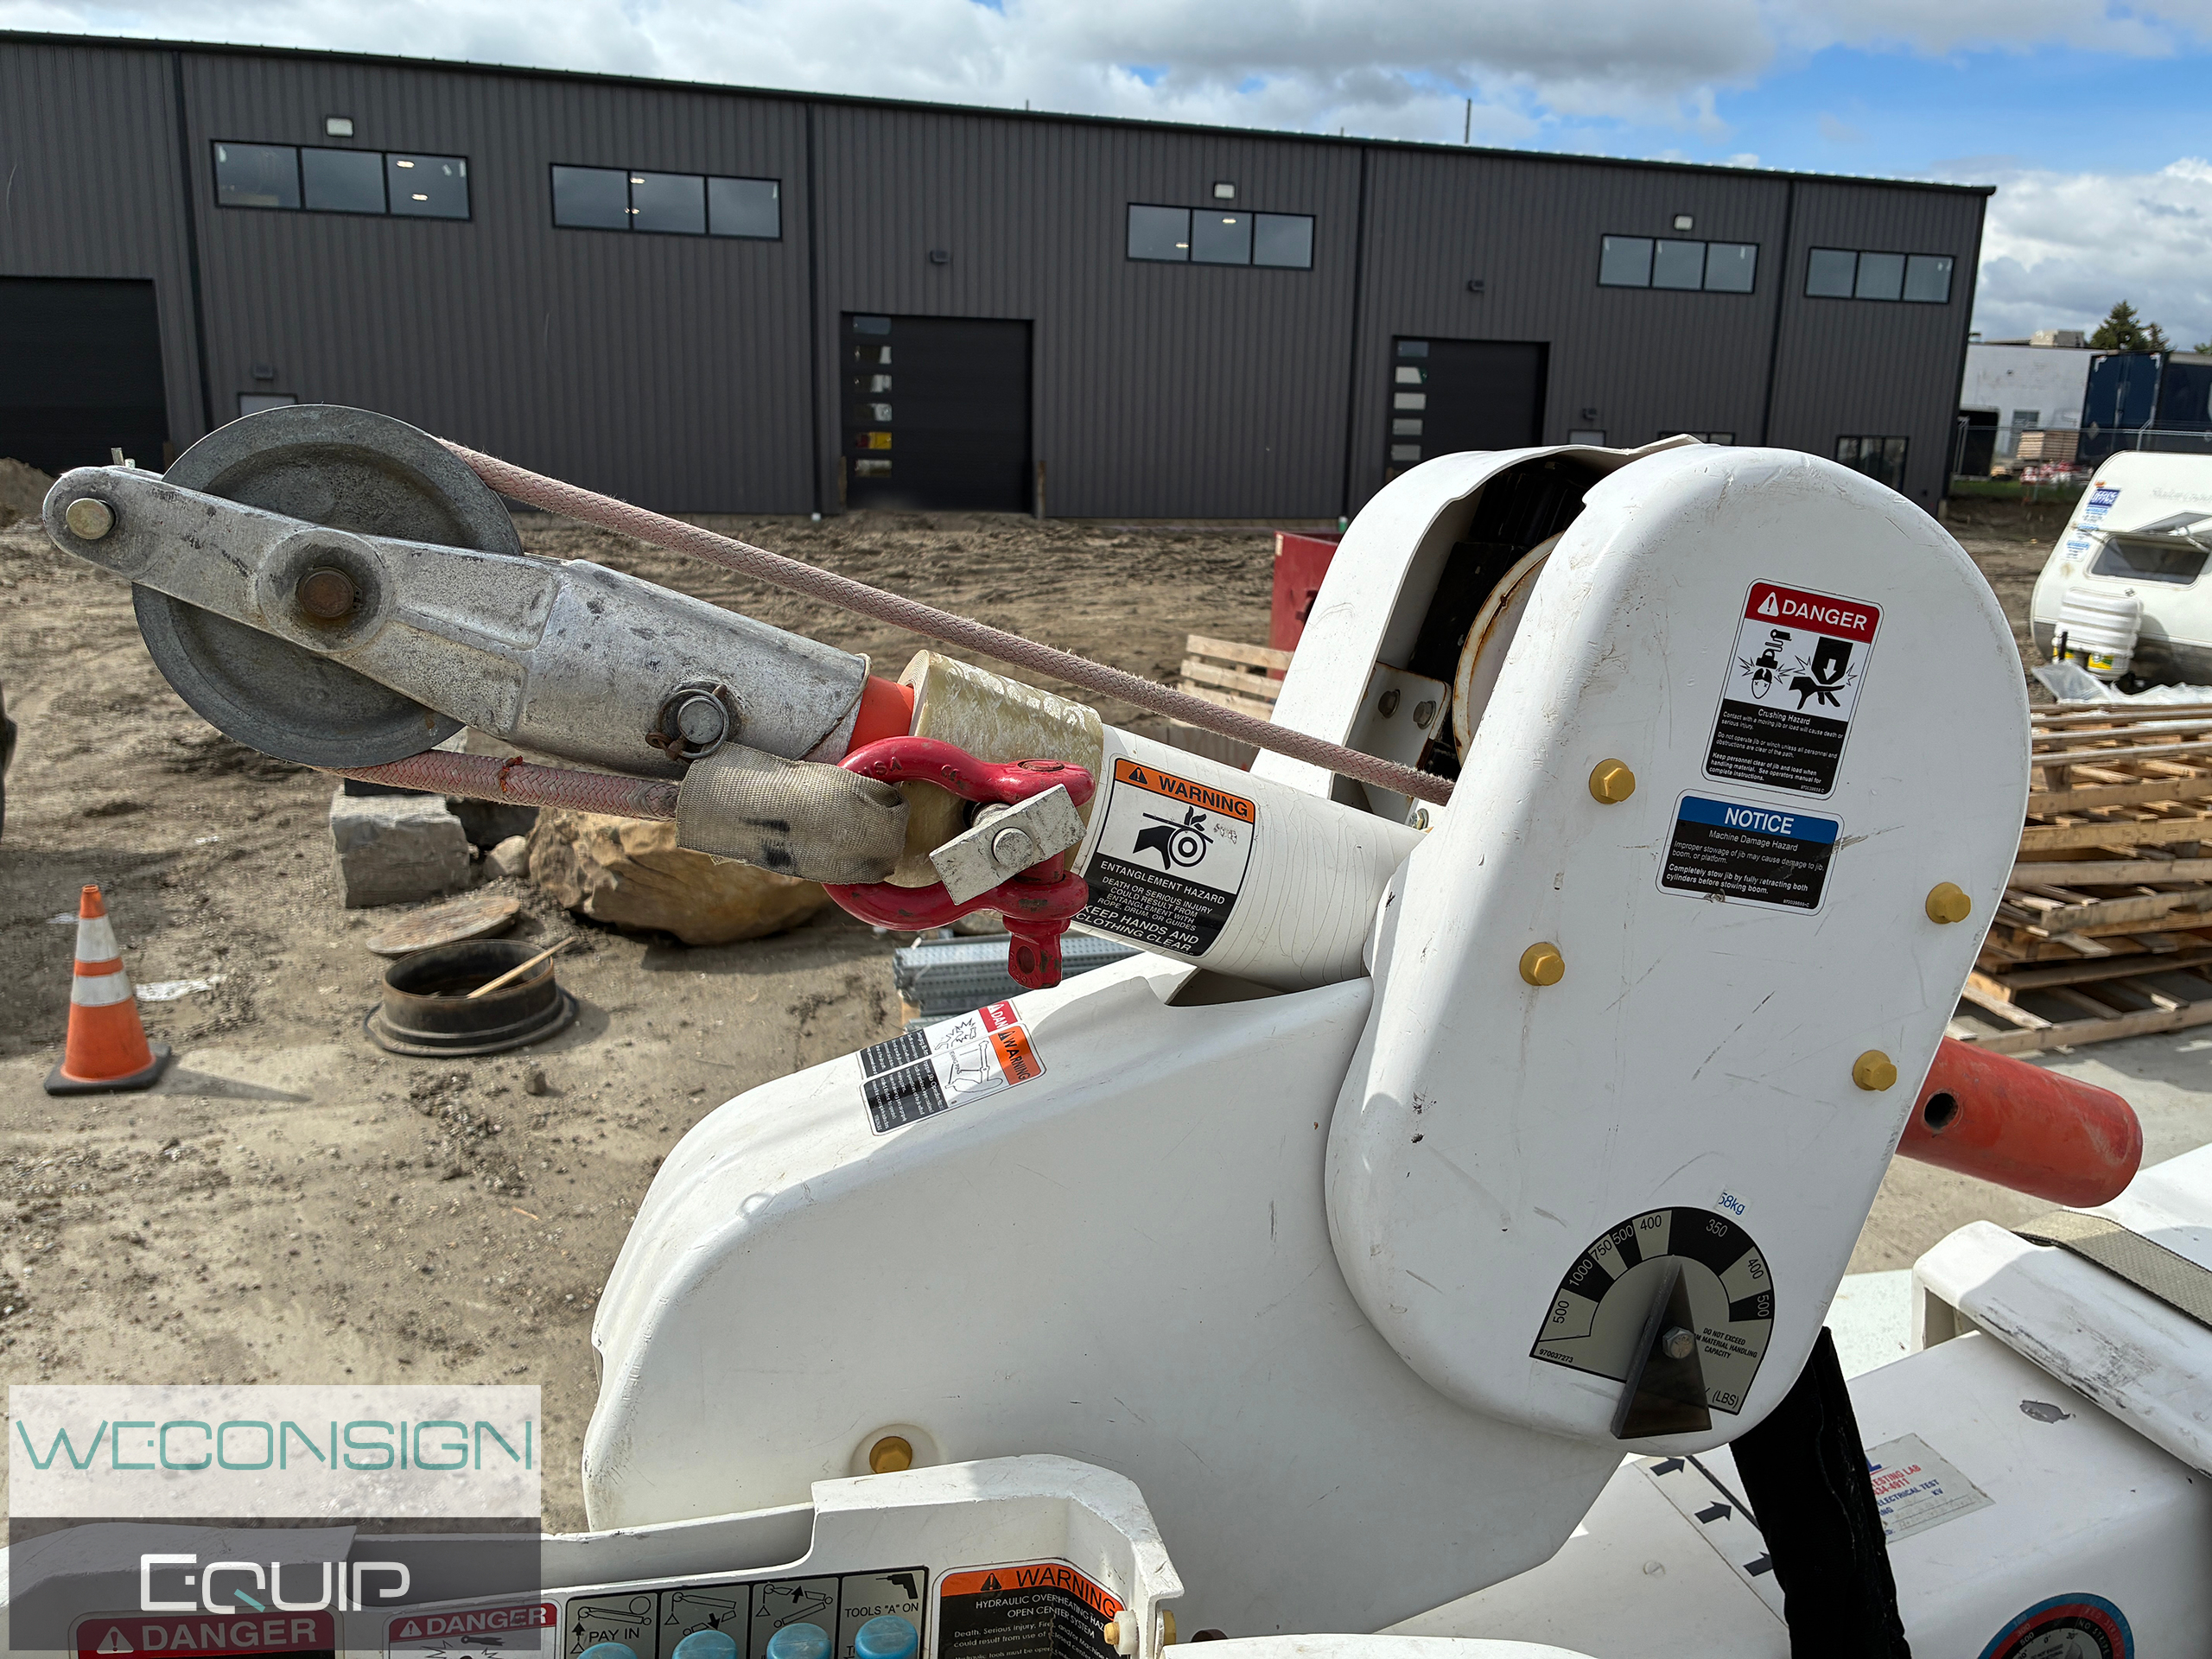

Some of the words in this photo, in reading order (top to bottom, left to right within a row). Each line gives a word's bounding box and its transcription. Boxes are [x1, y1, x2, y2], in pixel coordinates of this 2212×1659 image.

[1782, 599, 1866, 630] DANGER
[1723, 711, 1742, 720] Contact
[1739, 721, 1753, 730] injury.
[1758, 709, 1786, 721] Crushing
[1787, 714, 1810, 725] Hazard
[1716, 739, 1745, 748] obstructions
[1710, 759, 1732, 769] handling
[1769, 770, 1793, 779] operators
[1726, 755, 1752, 764] personnel
[1708, 766, 1732, 775] complete
[1732, 770, 1764, 780] instructions.
[1158, 775, 1247, 817] WARNING
[1724, 807, 1794, 834] NOTICE
[1708, 830, 1738, 842] Machine
[1740, 835, 1770, 848] Damage
[1771, 840, 1798, 851] Hazard
[1674, 840, 1703, 851] Improper
[1703, 846, 1729, 856] stowage
[1737, 850, 1745, 859] jib
[1746, 853, 1760, 861] may
[1781, 857, 1807, 868] damage
[1700, 854, 1727, 863] platform.
[1100, 861, 1182, 891] ENTANGLEMENT
[1183, 886, 1224, 904] HAZARD
[1666, 874, 1696, 883] cylinders
[1698, 877, 1719, 886] before
[1720, 880, 1746, 892] stowing
[1747, 884, 1768, 893] boom.
[1669, 863, 1706, 876] Completely
[1733, 874, 1742, 882] by
[1743, 874, 1758, 885] fully
[1759, 879, 1791, 890] retracting
[1792, 882, 1808, 891] both
[1102, 876, 1130, 889] DEATH
[1131, 885, 1144, 893] OR
[1145, 889, 1182, 905] SERIOUS
[1182, 900, 1212, 913] INJURY
[1110, 887, 1140, 899] COULD
[1141, 895, 1173, 910] RESULT
[1173, 906, 1198, 917] FROM
[1106, 893, 1173, 917] ENTANGLEMENT
[1173, 912, 1194, 924] WITH
[1076, 911, 1143, 937] CLOTHING
[1146, 933, 1191, 950] CLEAR
[1083, 903, 1118, 918] KEEP
[1120, 915, 1167, 934] HANDS
[1168, 931, 1198, 944] AND
[1165, 918, 1196, 931] GUIDES
[990, 1010, 1009, 1029] DAN
[1003, 1037, 1032, 1080] WARNING
[1640, 1215, 1662, 1231] 400
[1706, 1218, 1728, 1238] 350
[1611, 1224, 1635, 1245] 500
[1591, 1240, 1613, 1261] 750
[1568, 1259, 1593, 1287] 1000
[1748, 1258, 1764, 1280] 400
[1553, 1300, 1570, 1324] 500
[1757, 1294, 1770, 1317] 500
[1702, 1336, 1728, 1350] MATERIAL
[1729, 1344, 1758, 1358] HANDLING
[1713, 1330, 1724, 1338] NOT
[1724, 1334, 1746, 1346] EXCEED
[1539, 1349, 1573, 1363] 970037273
[1705, 1345, 1732, 1359] CAPACITY
[1712, 1389, 1739, 1408] (LBS)
[1902, 1464, 1922, 1476] LAB
[1919, 1478, 1940, 1491] TEST
[1930, 1487, 1944, 1497] KV
[1015, 1567, 1116, 1618] WARNING
[844, 1605, 881, 1618] TOOLS
[884, 1604, 899, 1614] "A"
[902, 1602, 919, 1612] ON
[976, 1595, 1029, 1610] HYDRAULIC
[1032, 1593, 1090, 1620] OVERHEATING
[1090, 1612, 1105, 1632] HAZ
[427, 1606, 549, 1636] DANGER
[1007, 1608, 1034, 1618] OPEN
[1036, 1605, 1070, 1622] CENTER
[1070, 1614, 1096, 1639] SYSTEM
[2079, 1618, 2091, 1630] NO
[142, 1618, 317, 1652] DANGER
[588, 1628, 620, 1643] PAY
[624, 1627, 639, 1640] IN
[953, 1639, 977, 1648] could
[978, 1637, 1001, 1645] result
[983, 1625, 1011, 1635] Serious
[1058, 1624, 1078, 1641] and/or
[1079, 1637, 1105, 1659] Machine
[2019, 1632, 2035, 1646] 500
[988, 1650, 1005, 1659] tools
